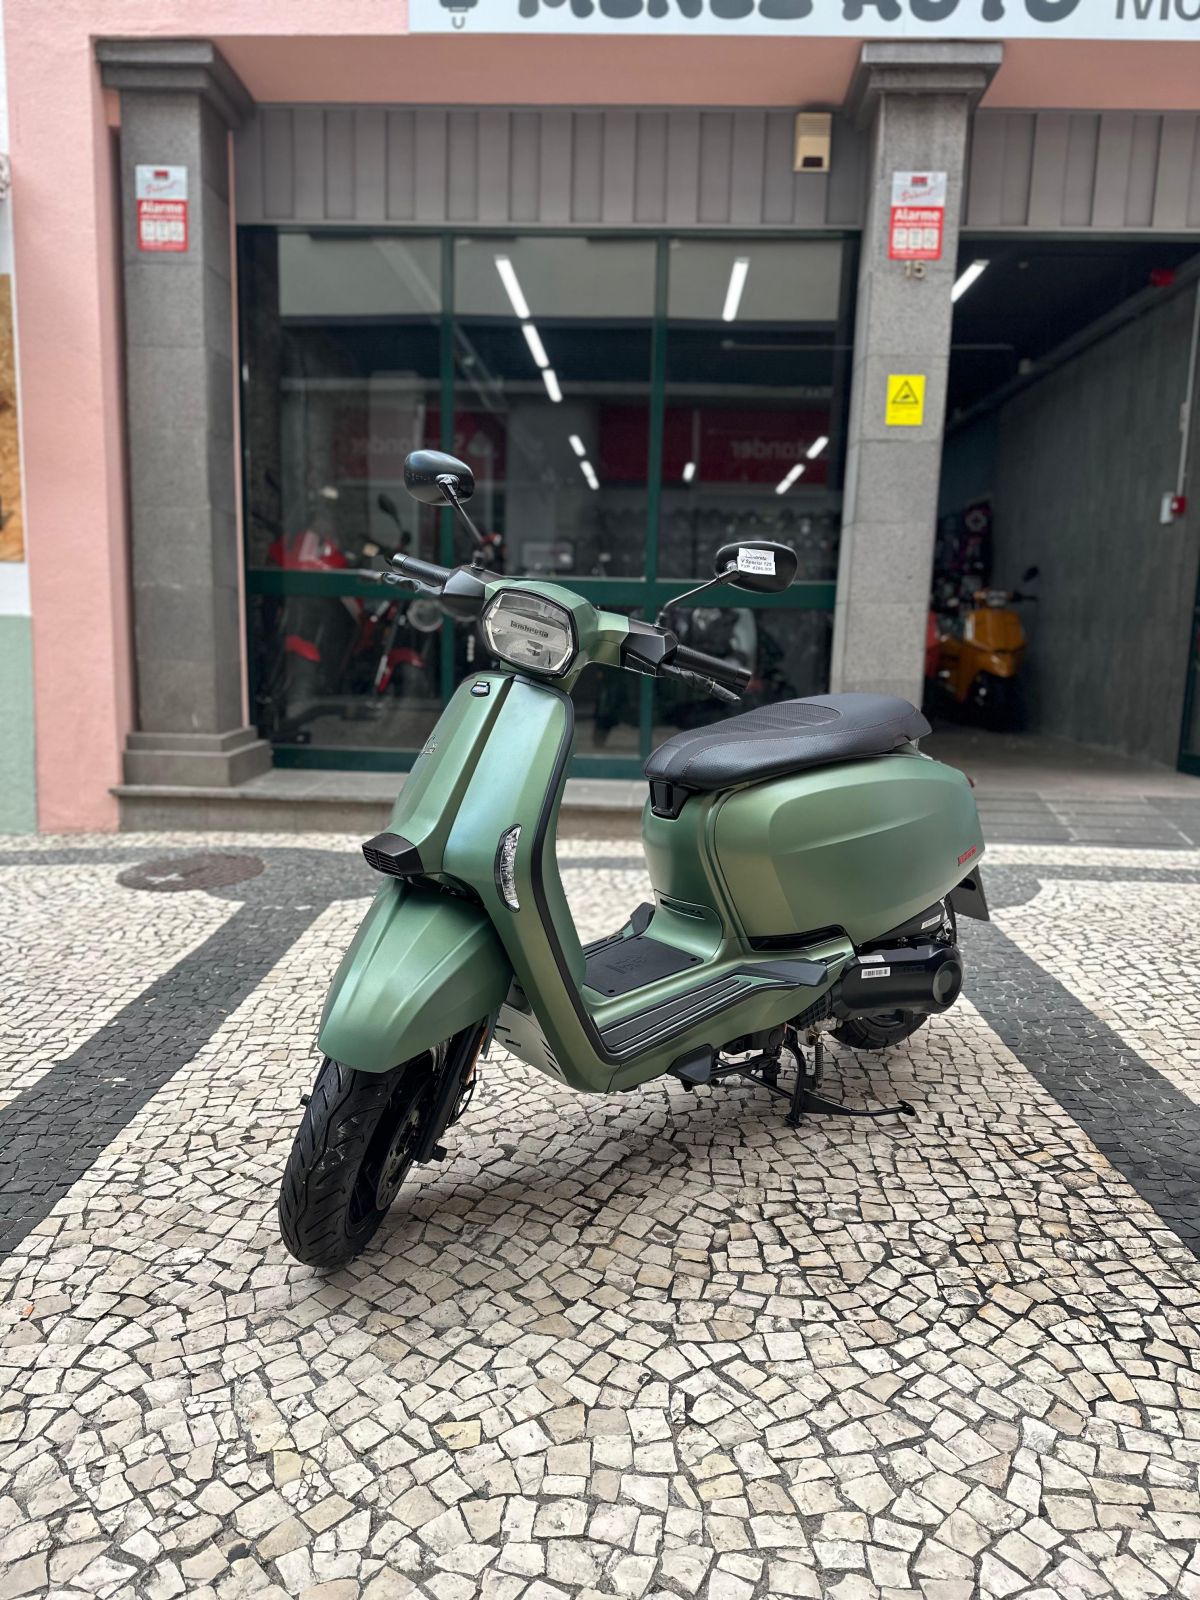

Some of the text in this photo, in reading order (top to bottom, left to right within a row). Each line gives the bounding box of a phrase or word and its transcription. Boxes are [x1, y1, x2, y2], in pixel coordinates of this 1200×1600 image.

[140, 200, 184, 214] Alarme
[894, 207, 941, 221] Alarme
[903, 259, 927, 280] 15
